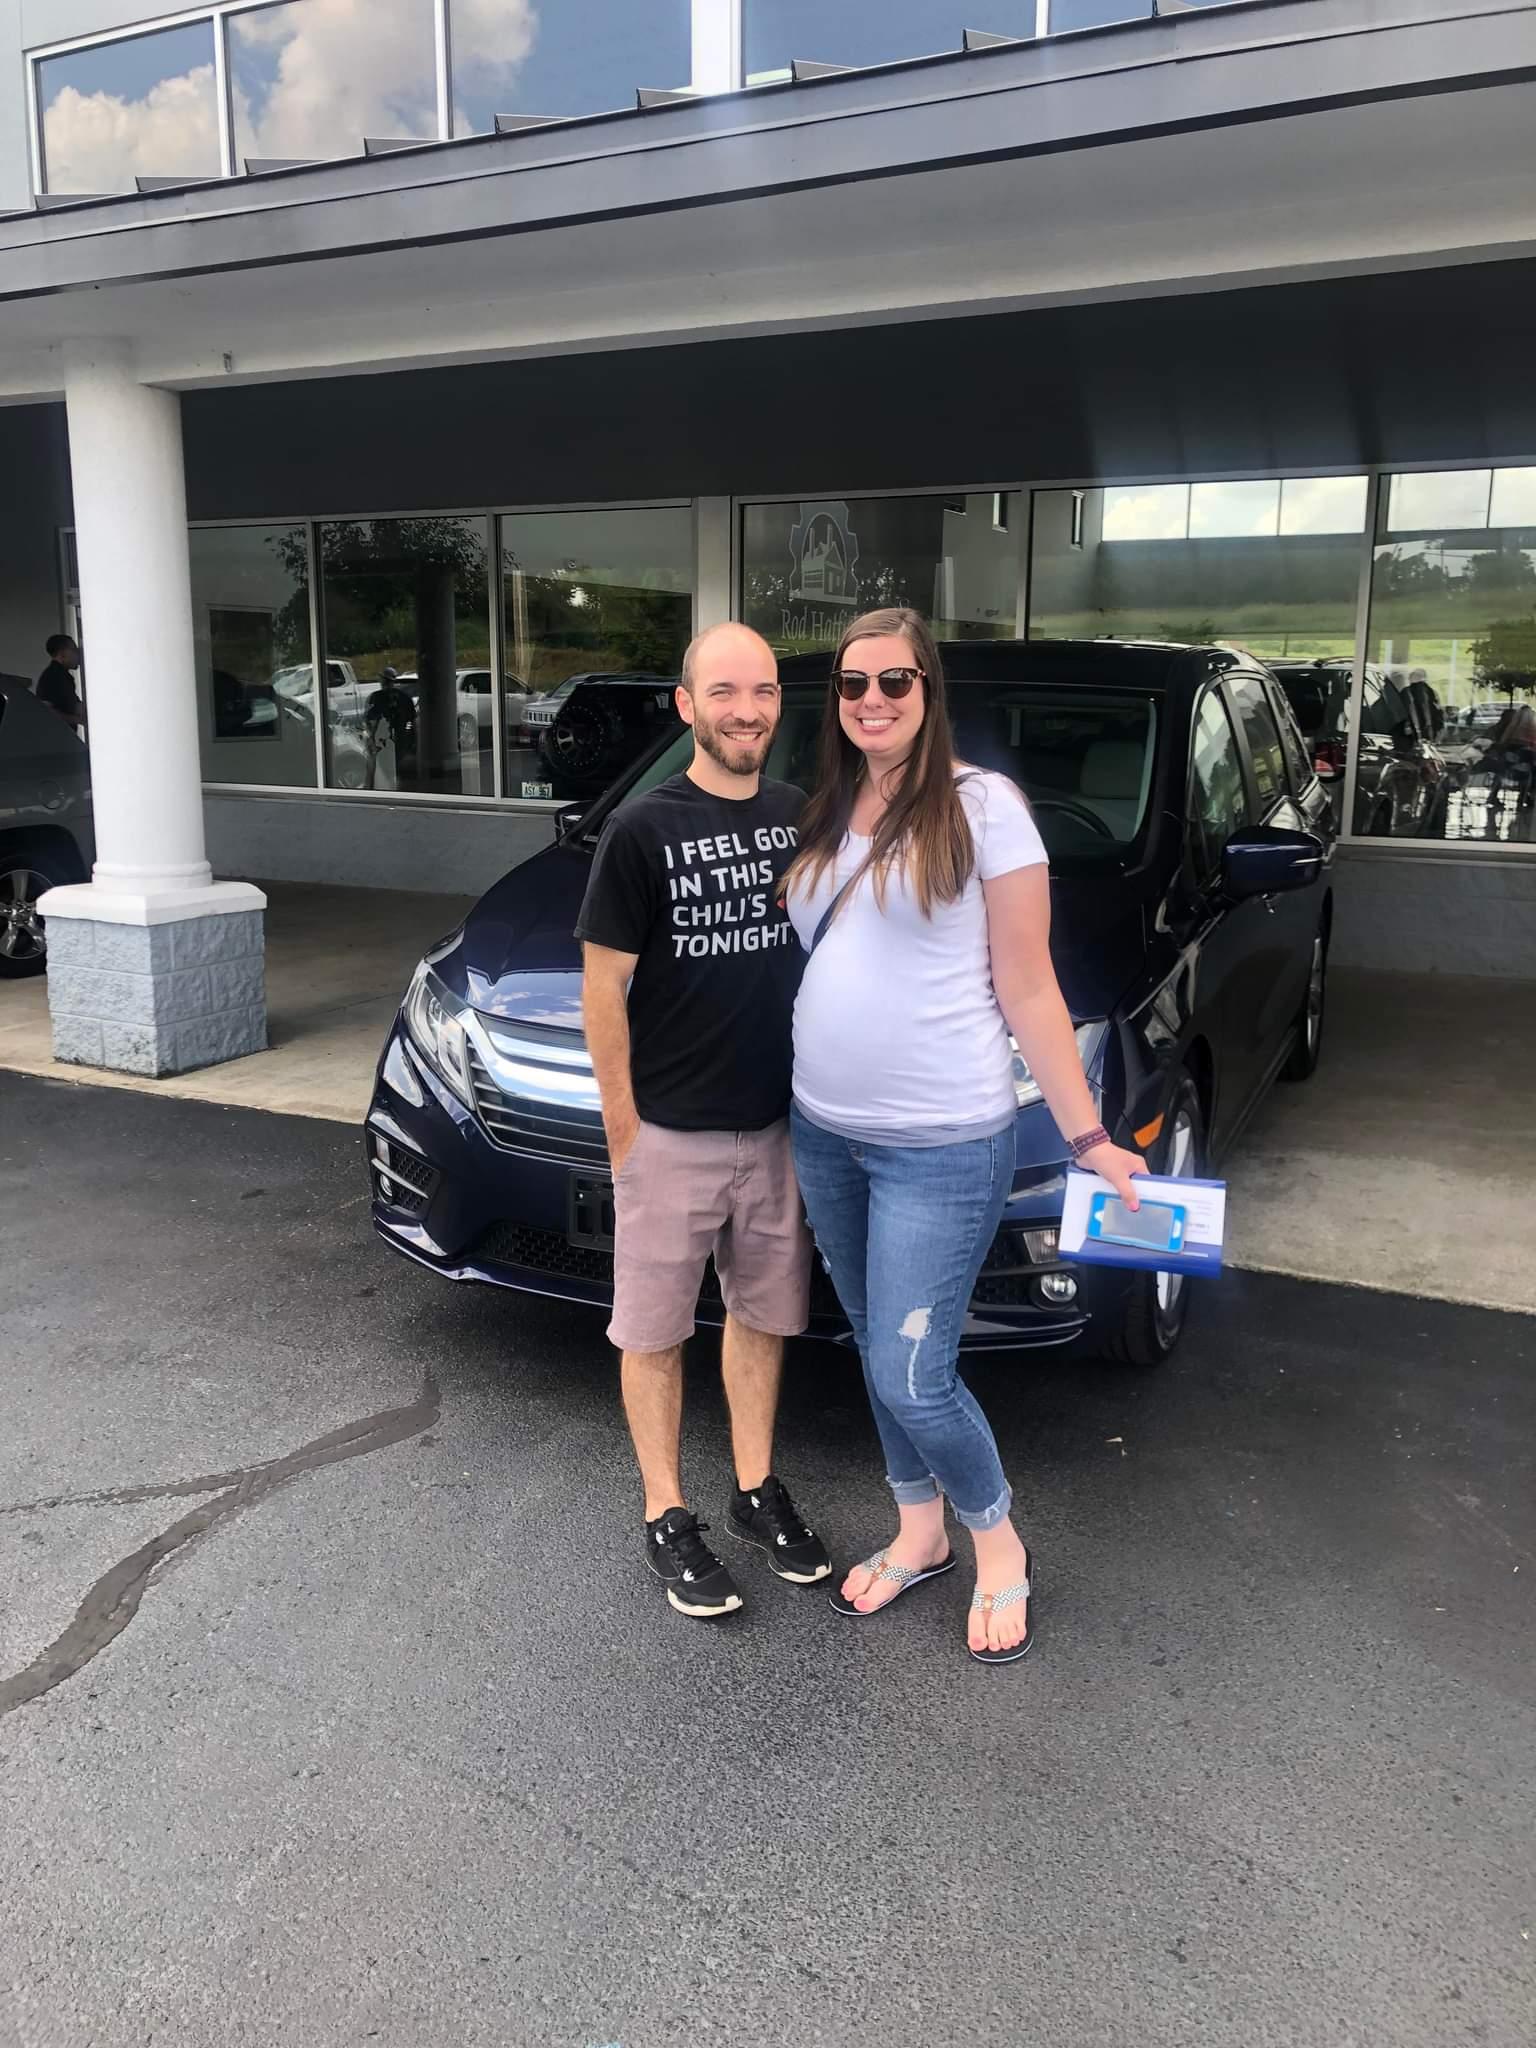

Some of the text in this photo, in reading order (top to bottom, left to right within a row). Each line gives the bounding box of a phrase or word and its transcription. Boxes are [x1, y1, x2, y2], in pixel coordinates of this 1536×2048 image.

[780, 605, 808, 641] Rod
[664, 845, 674, 869] I
[681, 833, 749, 865] FEEL
[670, 859, 773, 900] IN THIS
[672, 893, 767, 926] CHILI'S
